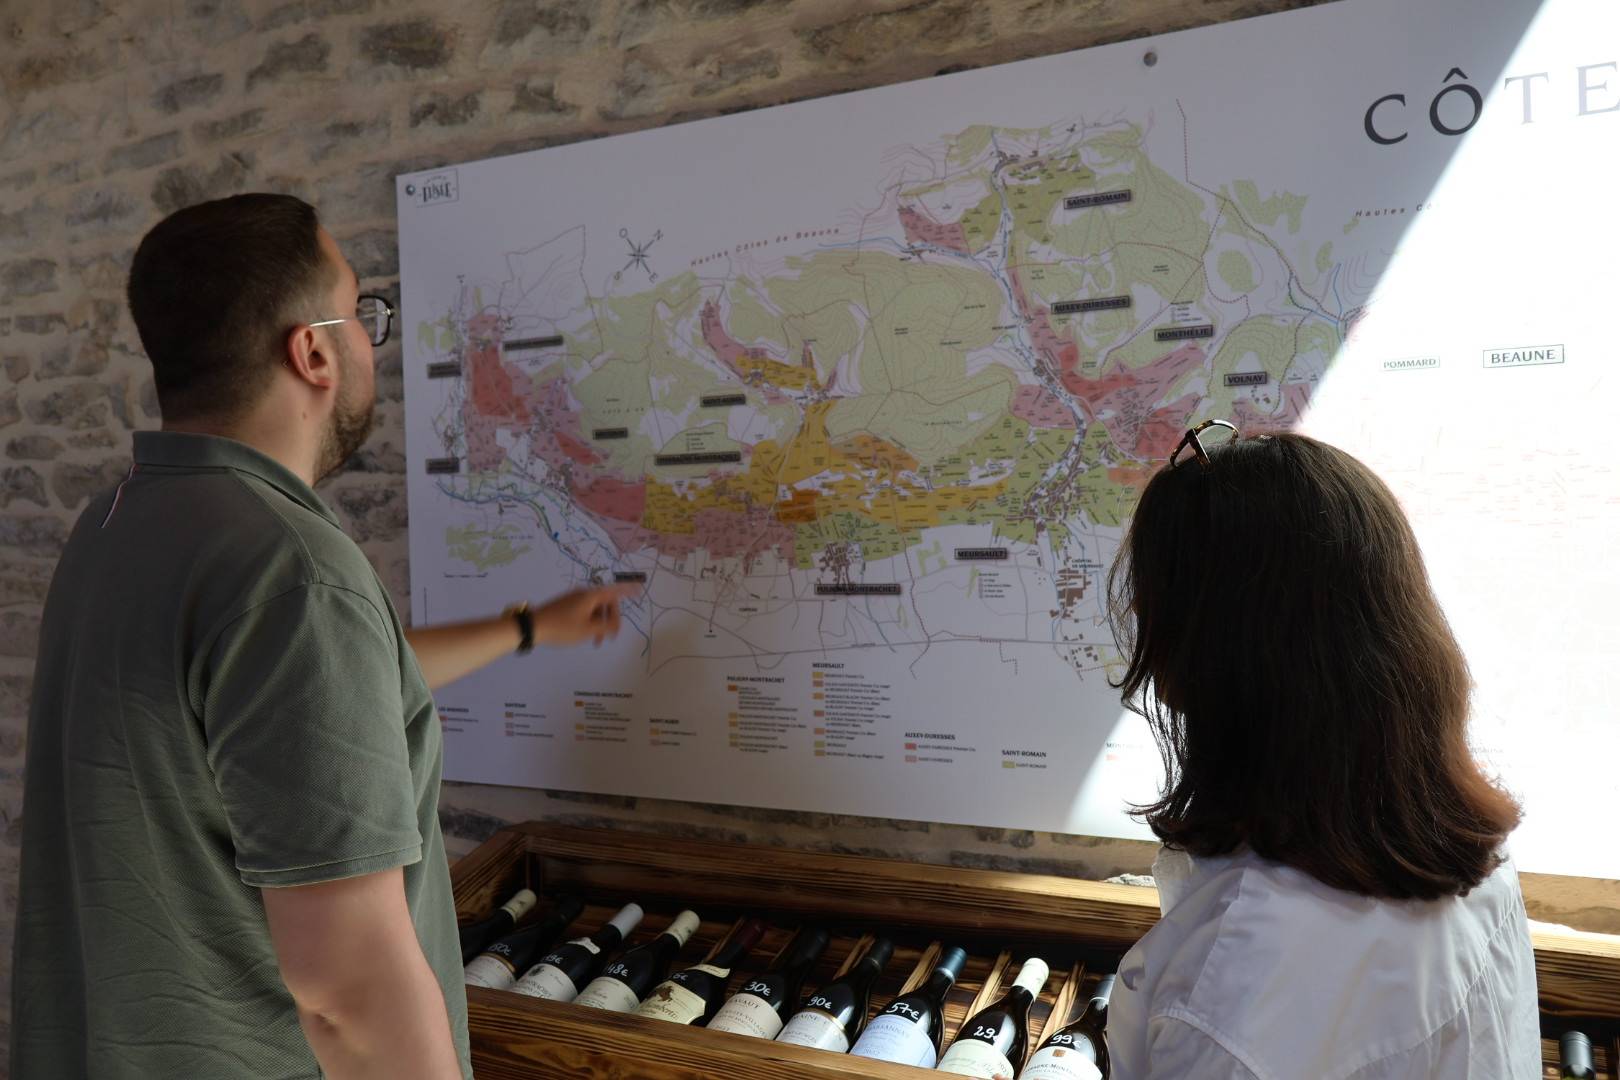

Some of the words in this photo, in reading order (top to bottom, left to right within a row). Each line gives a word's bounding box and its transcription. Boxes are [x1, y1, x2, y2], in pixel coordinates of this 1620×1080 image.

[1364, 60, 1620, 145] CÔTE
[1383, 357, 1437, 369] POMMARD
[1491, 348, 1556, 364] BEAUNE
[744, 981, 772, 997] 30€
[885, 1002, 920, 1021] 57€
